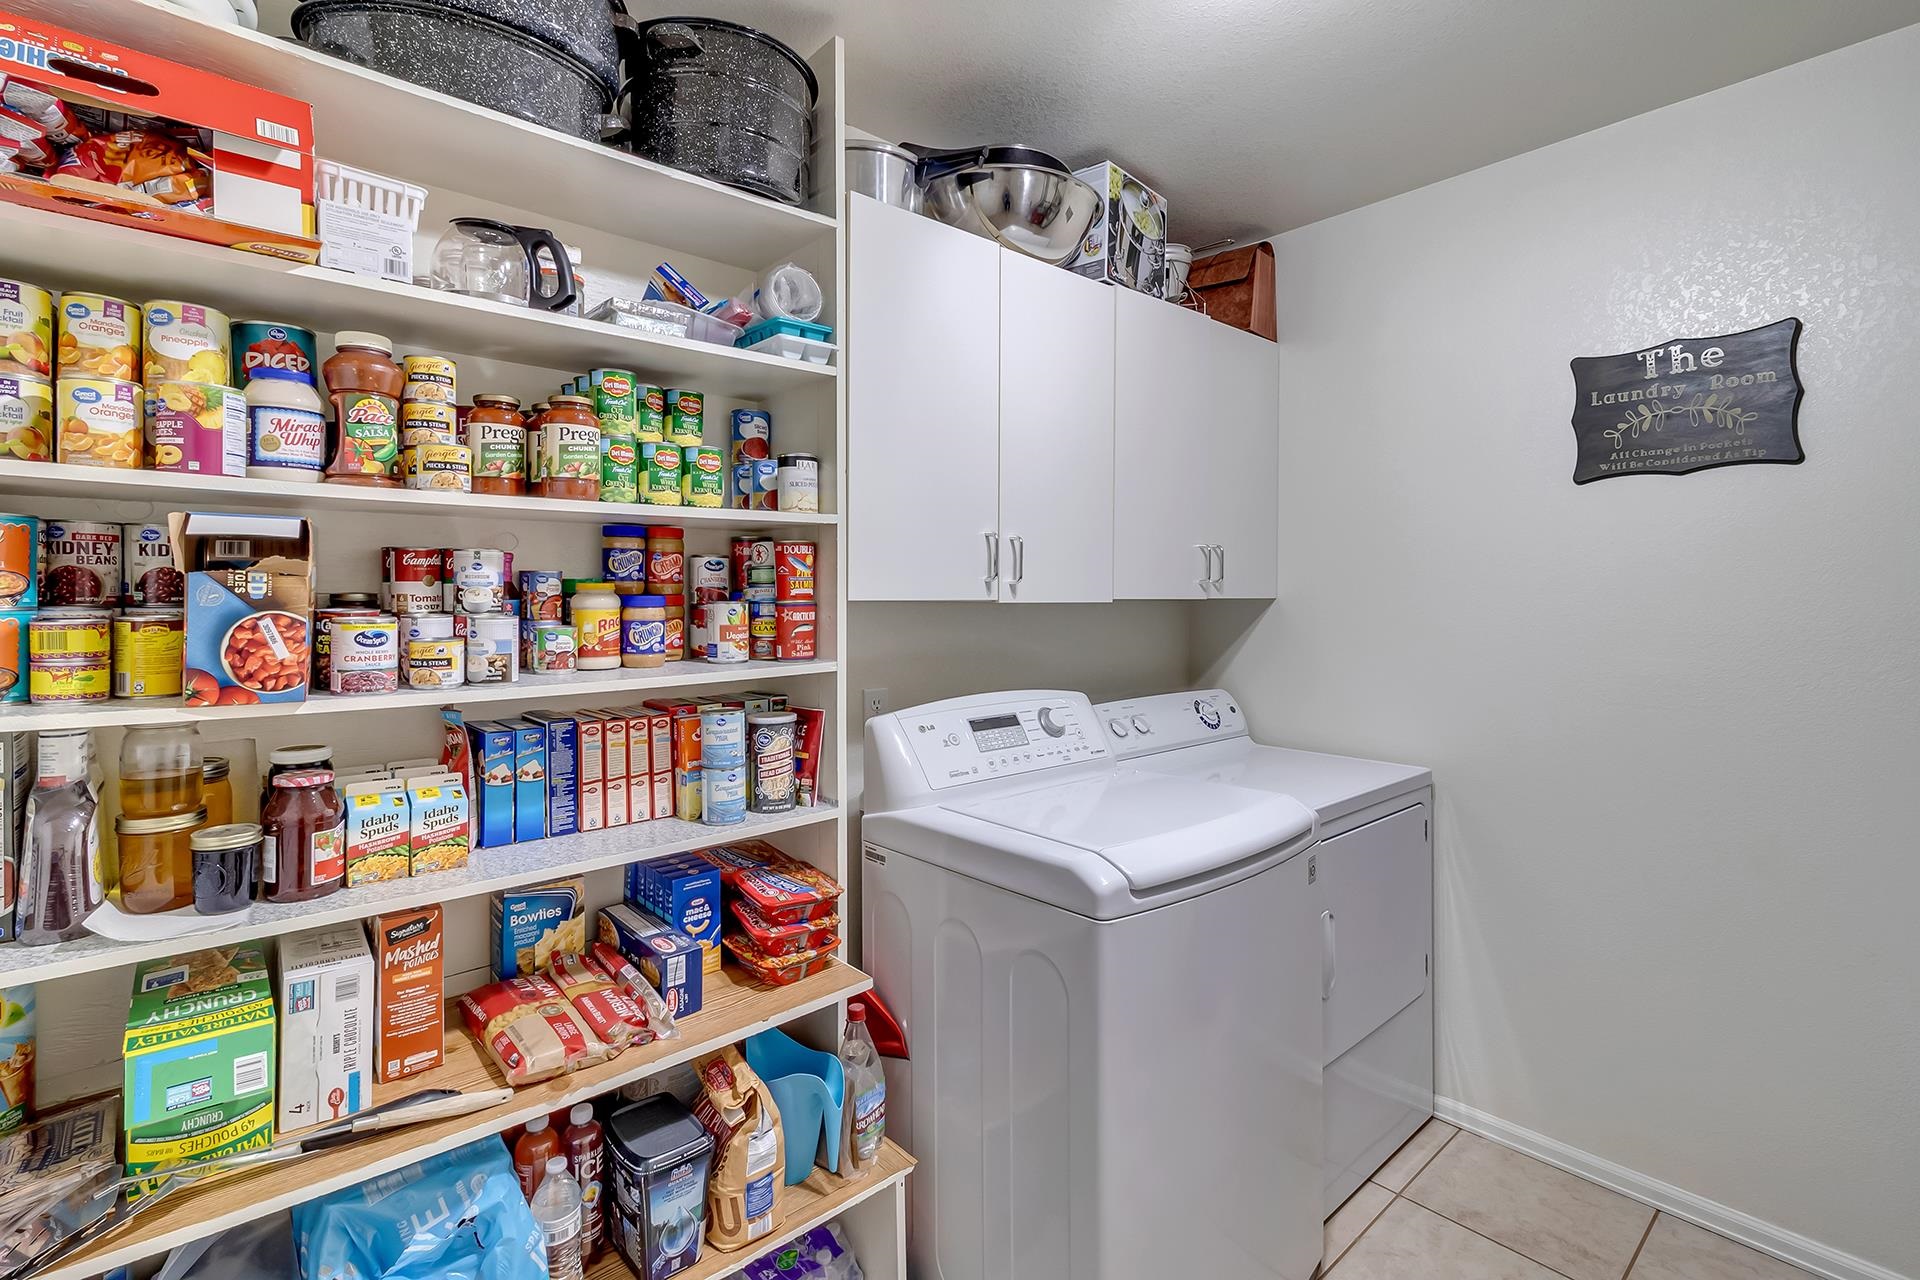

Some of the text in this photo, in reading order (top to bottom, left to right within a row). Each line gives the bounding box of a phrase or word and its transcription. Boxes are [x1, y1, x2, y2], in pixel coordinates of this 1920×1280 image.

[0, 315, 23, 325] cktail
[4, 308, 23, 318] Fruit
[79, 322, 125, 337] Oranges
[161, 334, 208, 348] Pineapple
[245, 351, 310, 372] DICED
[1637, 344, 1725, 379] The
[1591, 370, 1778, 406] Laundry Room
[0, 411, 23, 420] cktail
[3, 404, 23, 413] Fruit
[347, 408, 394, 425] Pace
[269, 418, 324, 434] Miracle
[355, 428, 390, 438] SALSA
[481, 425, 525, 444] Prego
[280, 431, 320, 450] Whip
[559, 426, 599, 446] Prego
[1610, 450, 1630, 460] All
[1632, 446, 1681, 457] Change
[1700, 438, 1753, 450] Pockets
[1599, 461, 1626, 471] Will
[1645, 454, 1721, 467] Considered
[1744, 447, 1767, 459] Tip
[47, 541, 114, 555] KIDNEY
[138, 543, 171, 557] KID
[76, 555, 118, 565] BEANS
[612, 551, 643, 571] CRUNCHY
[597, 617, 620, 634] RAG
[632, 623, 663, 643] CRUNCHY
[343, 654, 396, 663] CRANBERRY
[760, 749, 792, 764] TRADITIONAL
[361, 812, 399, 829] Idaho
[424, 804, 459, 820] Idaho
[422, 814, 459, 830] Spuds
[360, 822, 399, 840] Spuds
[421, 825, 461, 841] HASHBROWN
[428, 833, 454, 845] Potatoes
[358, 834, 401, 851] HASHBROWN
[366, 842, 394, 854] Potatoes
[510, 907, 562, 927] Bowties
[513, 929, 540, 941] macaroni
[514, 924, 538, 935] Enriched
[513, 936, 536, 947] product
[385, 933, 441, 970] Mashed
[403, 948, 440, 972] POTATOES
[146, 990, 257, 1024] CRUNCHY
[178, 1005, 247, 1028] POUCHES
[132, 1008, 270, 1049] NATURE VALLEY
[343, 1007, 358, 1073] TRIPLE CHOCOLATE
[288, 1103, 305, 1114] 4
[857, 1103, 886, 1130] RROWHEA
[181, 1110, 224, 1132] CRUNCHY
[240, 1118, 255, 1133] 49
[179, 1127, 239, 1154] POUCHES
[574, 1149, 602, 1163] SPARKL
